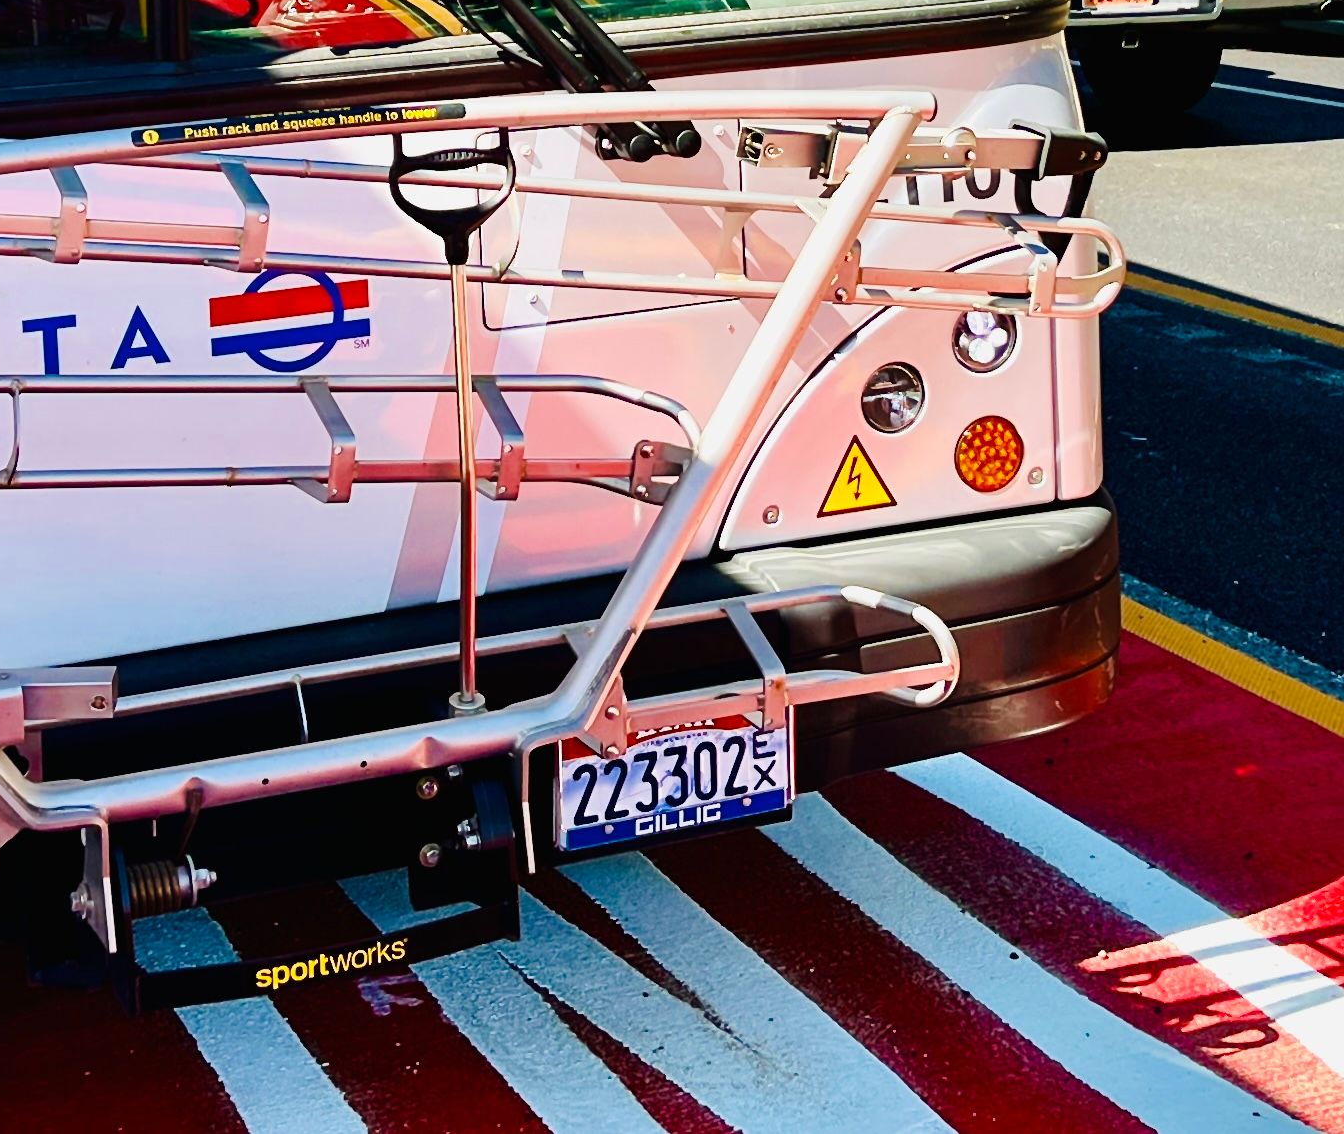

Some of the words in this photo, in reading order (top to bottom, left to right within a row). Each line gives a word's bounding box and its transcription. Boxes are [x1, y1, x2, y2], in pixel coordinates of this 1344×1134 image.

[184, 126, 218, 139] Push
[222, 123, 251, 135] rack
[255, 120, 279, 132] and
[283, 114, 336, 131] squeeze
[339, 111, 382, 125] handle
[385, 110, 399, 121] to
[402, 106, 437, 120] lower
[572, 735, 749, 826] 223302
[635, 802, 722, 837] GILLIG
[256, 939, 407, 991] sportworks
